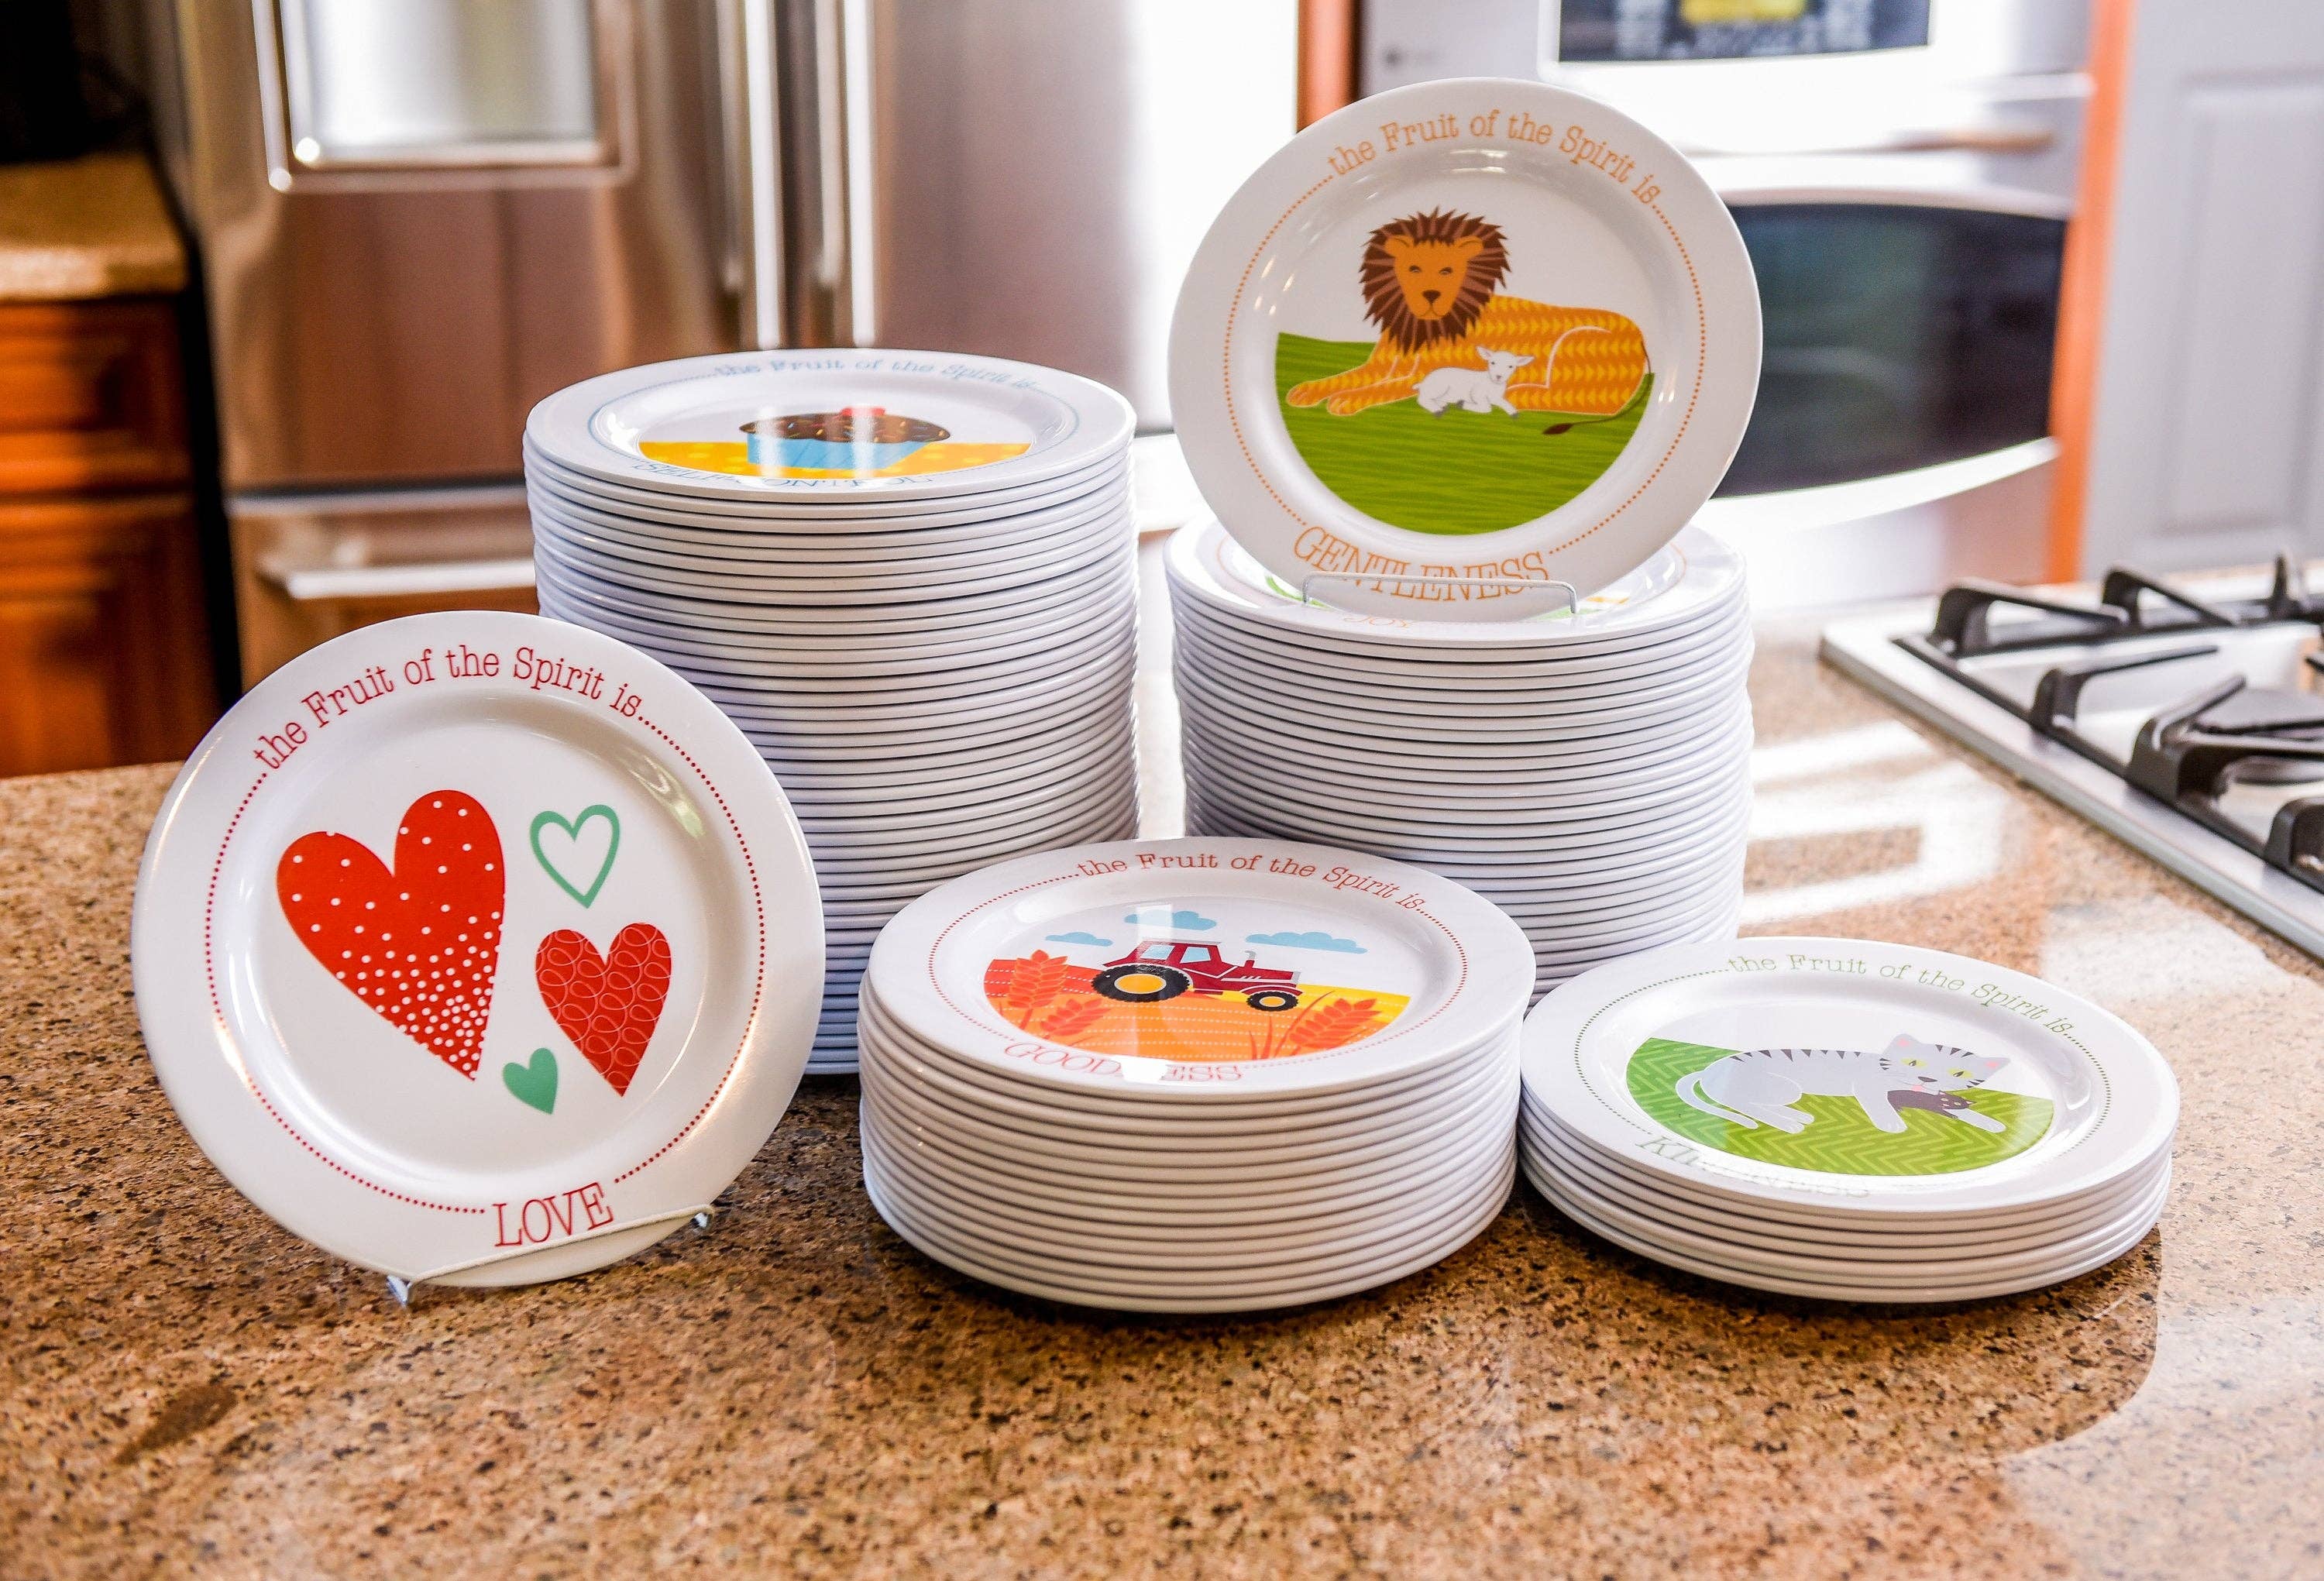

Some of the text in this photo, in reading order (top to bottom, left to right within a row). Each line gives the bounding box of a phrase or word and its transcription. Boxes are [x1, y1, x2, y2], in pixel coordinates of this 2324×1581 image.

[1329, 139, 1376, 176] the
[1380, 114, 1459, 153] Fruit
[1470, 109, 1501, 137] of
[1508, 112, 1552, 145] the
[1559, 125, 1635, 183] Spirit
[1294, 526, 1549, 601] GENTLENESS
[254, 720, 308, 769] the
[301, 665, 395, 729] Fruit
[404, 648, 435, 685] of
[445, 644, 500, 678] the
[513, 646, 606, 700] Spirit
[1077, 859, 1127, 876] the
[1136, 852, 1219, 869] Fruit
[1230, 854, 1261, 870] of
[1269, 859, 1316, 877] the
[1322, 866, 1400, 899] Spirit
[1728, 955, 1776, 972] the
[1786, 954, 1867, 974] Fruit
[1879, 964, 1912, 981] of
[1917, 969, 1965, 992] the
[1970, 982, 2051, 1020] Spirit
[492, 1181, 614, 1247] LOVE
